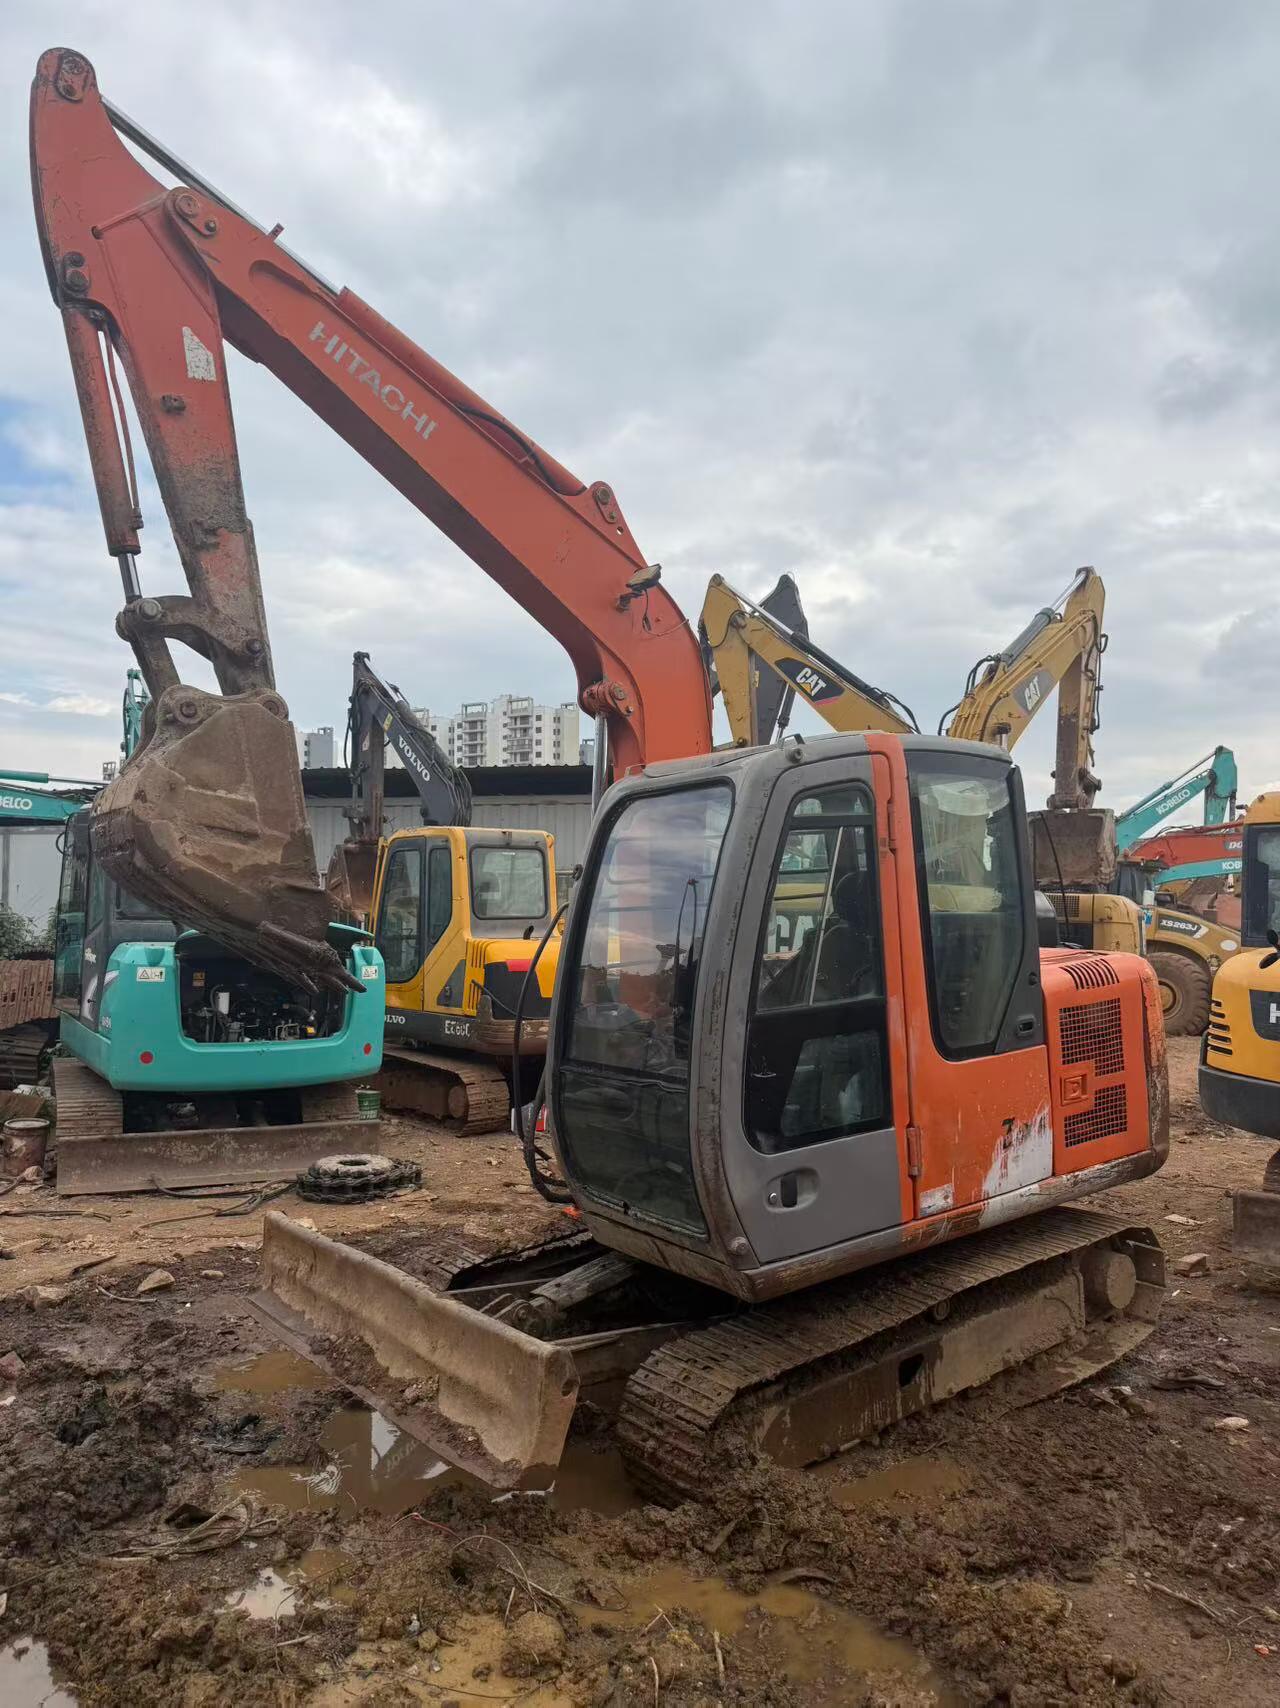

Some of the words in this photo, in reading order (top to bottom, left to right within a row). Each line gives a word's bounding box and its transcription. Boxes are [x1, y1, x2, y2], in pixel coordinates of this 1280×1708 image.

[308, 320, 438, 441] HITACHI
[795, 667, 827, 697] CAT
[1024, 676, 1041, 711] CAT
[398, 734, 431, 782] VOLVO
[0, 796, 33, 811] ELCO
[1155, 788, 1191, 815] KOBELCO
[384, 1015, 406, 1025] LVO
